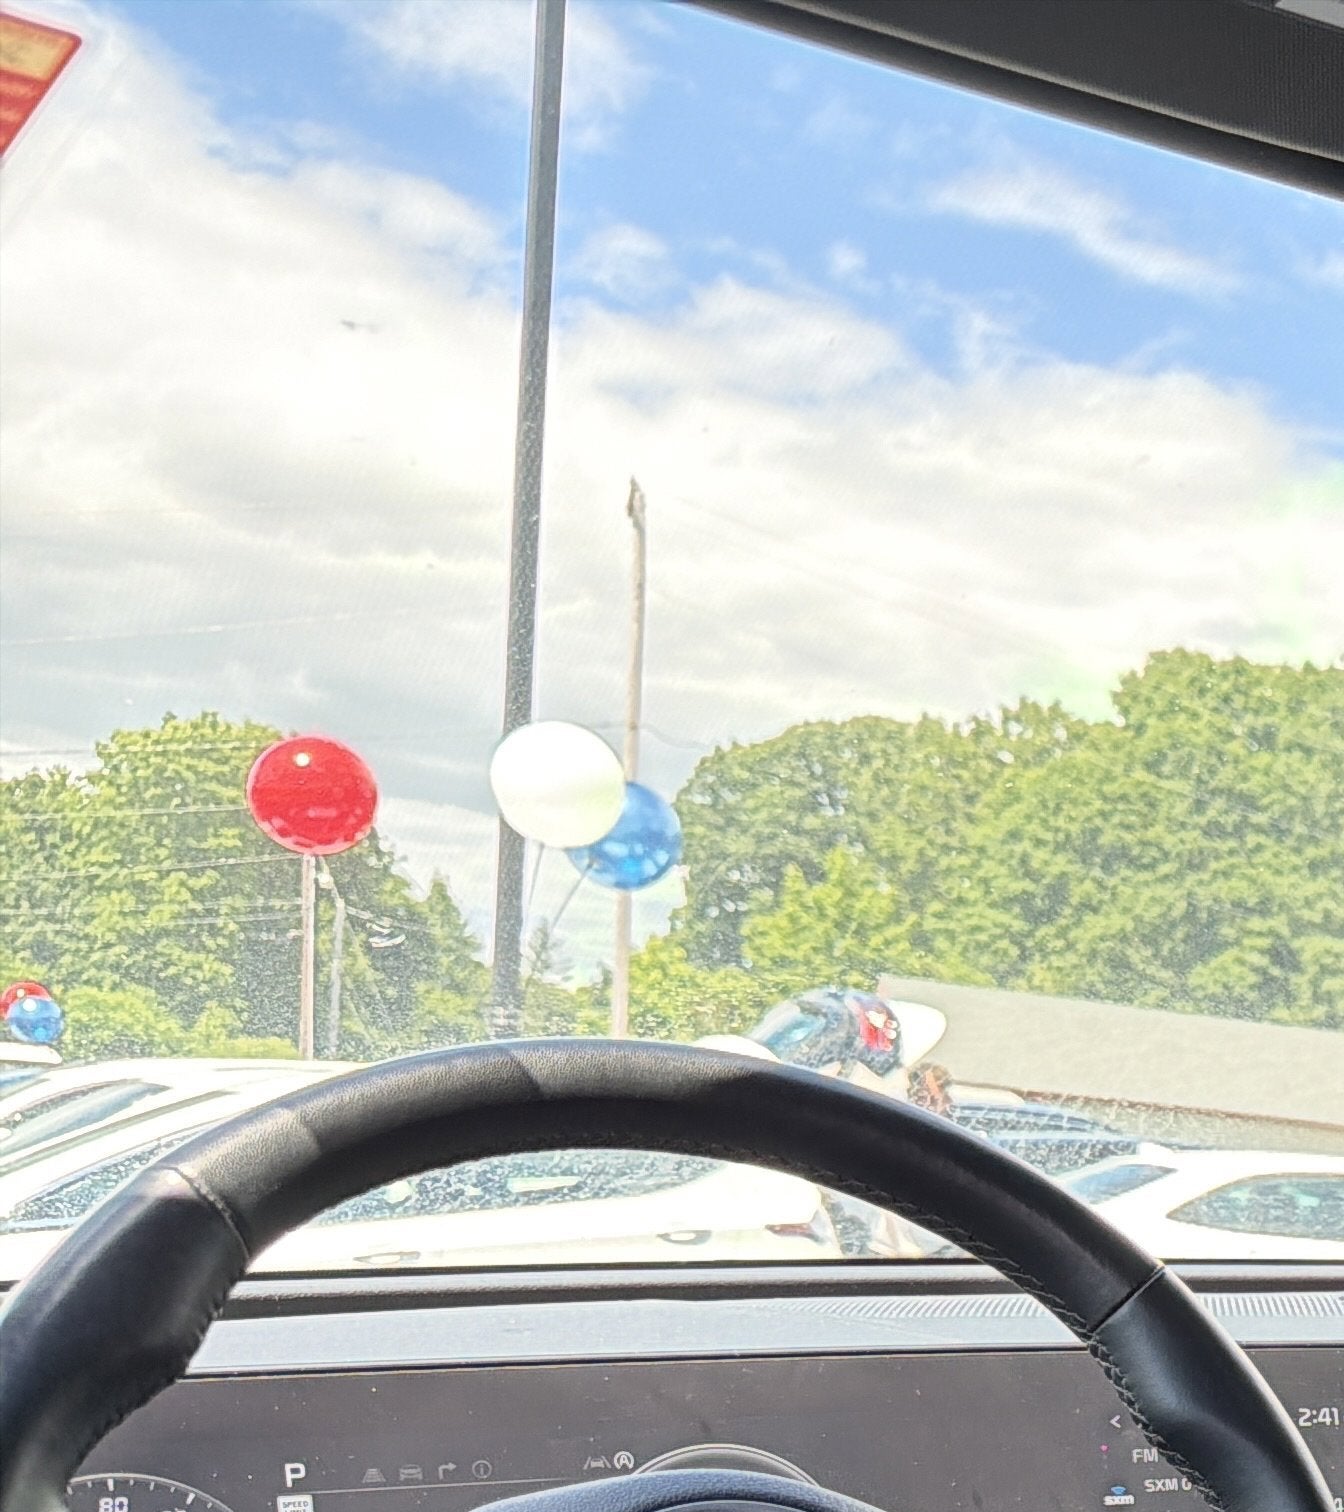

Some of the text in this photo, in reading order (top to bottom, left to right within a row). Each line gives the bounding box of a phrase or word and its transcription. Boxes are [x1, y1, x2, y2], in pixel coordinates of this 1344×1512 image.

[1298, 1407, 1340, 1427] 2:41
[1132, 1448, 1159, 1464] FM
[284, 1462, 306, 1488] P
[1144, 1478, 1178, 1493] SXM
[282, 1500, 309, 1509] SPEED
